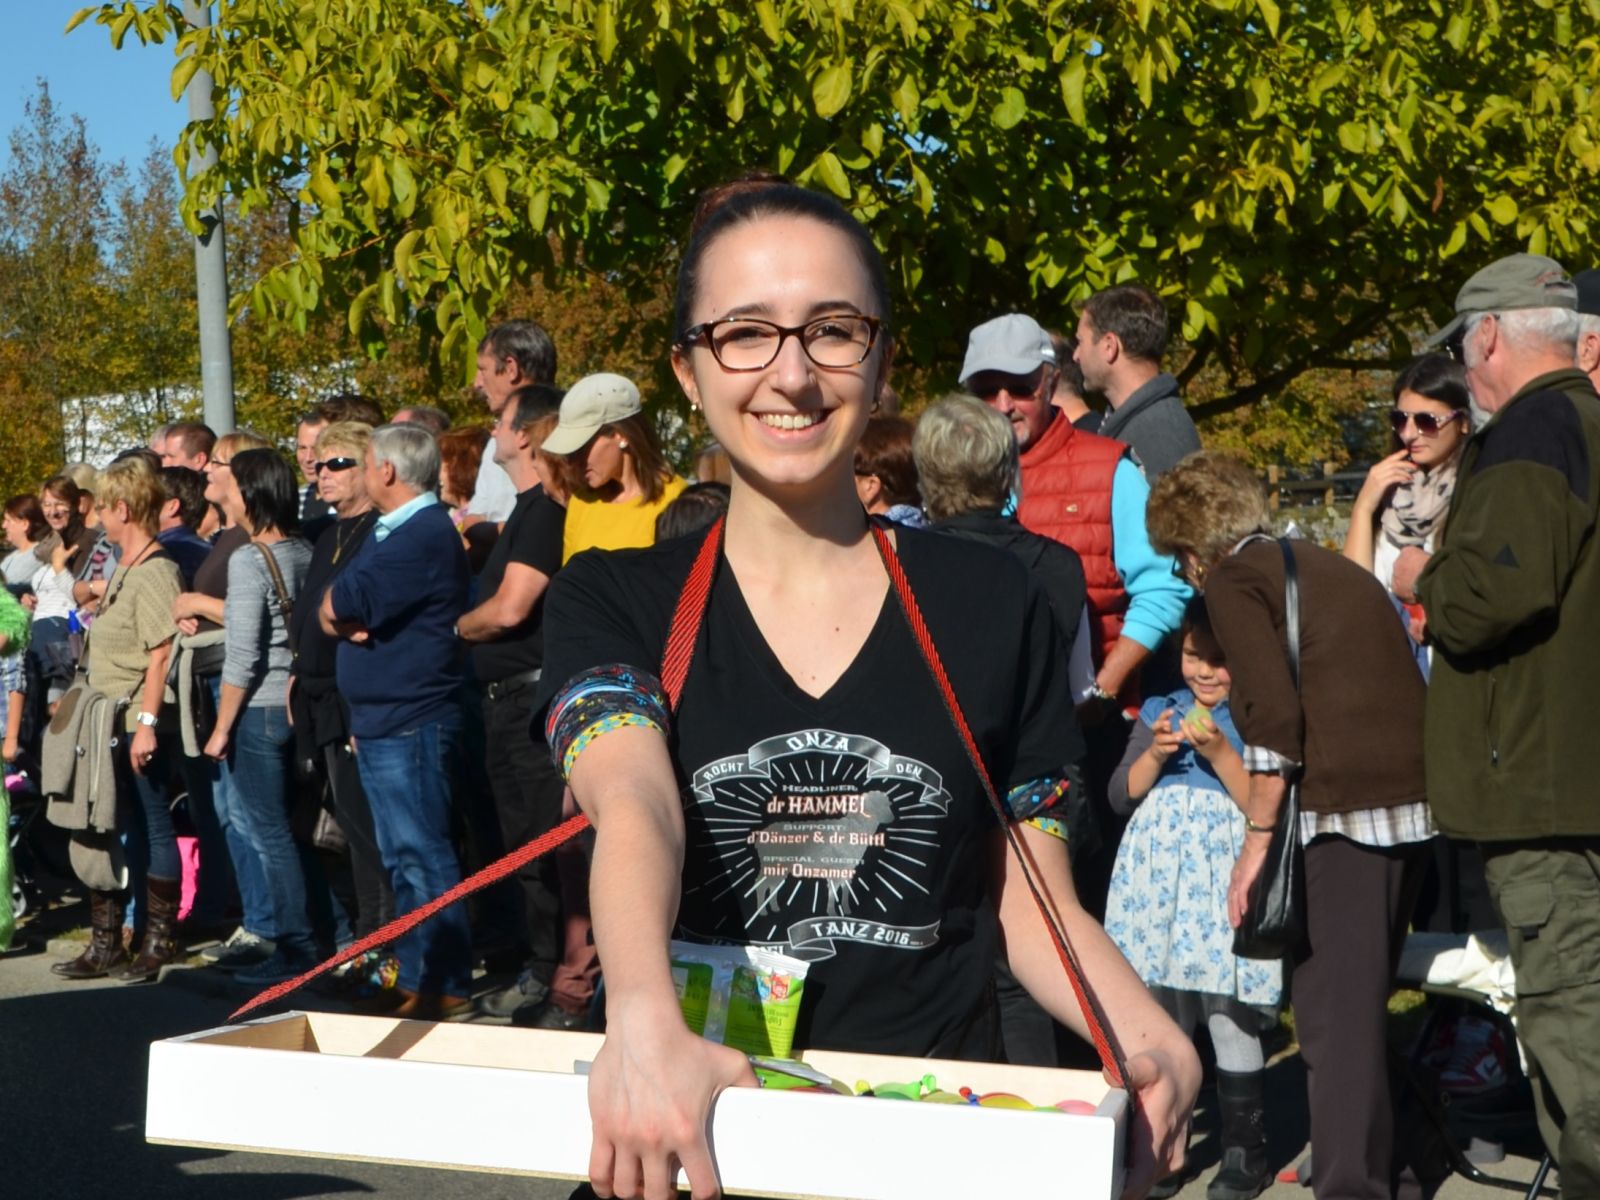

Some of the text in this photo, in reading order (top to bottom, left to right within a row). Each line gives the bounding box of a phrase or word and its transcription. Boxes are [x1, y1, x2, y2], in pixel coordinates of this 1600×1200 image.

[785, 732, 849, 750] ONZA
[895, 763, 923, 779] DEN
[767, 795, 871, 818] dr HAMMEL
[813, 831, 825, 844] &
[829, 832, 845, 844] dr
[763, 864, 788, 877] mir
[810, 921, 911, 945] TANZ 2016
